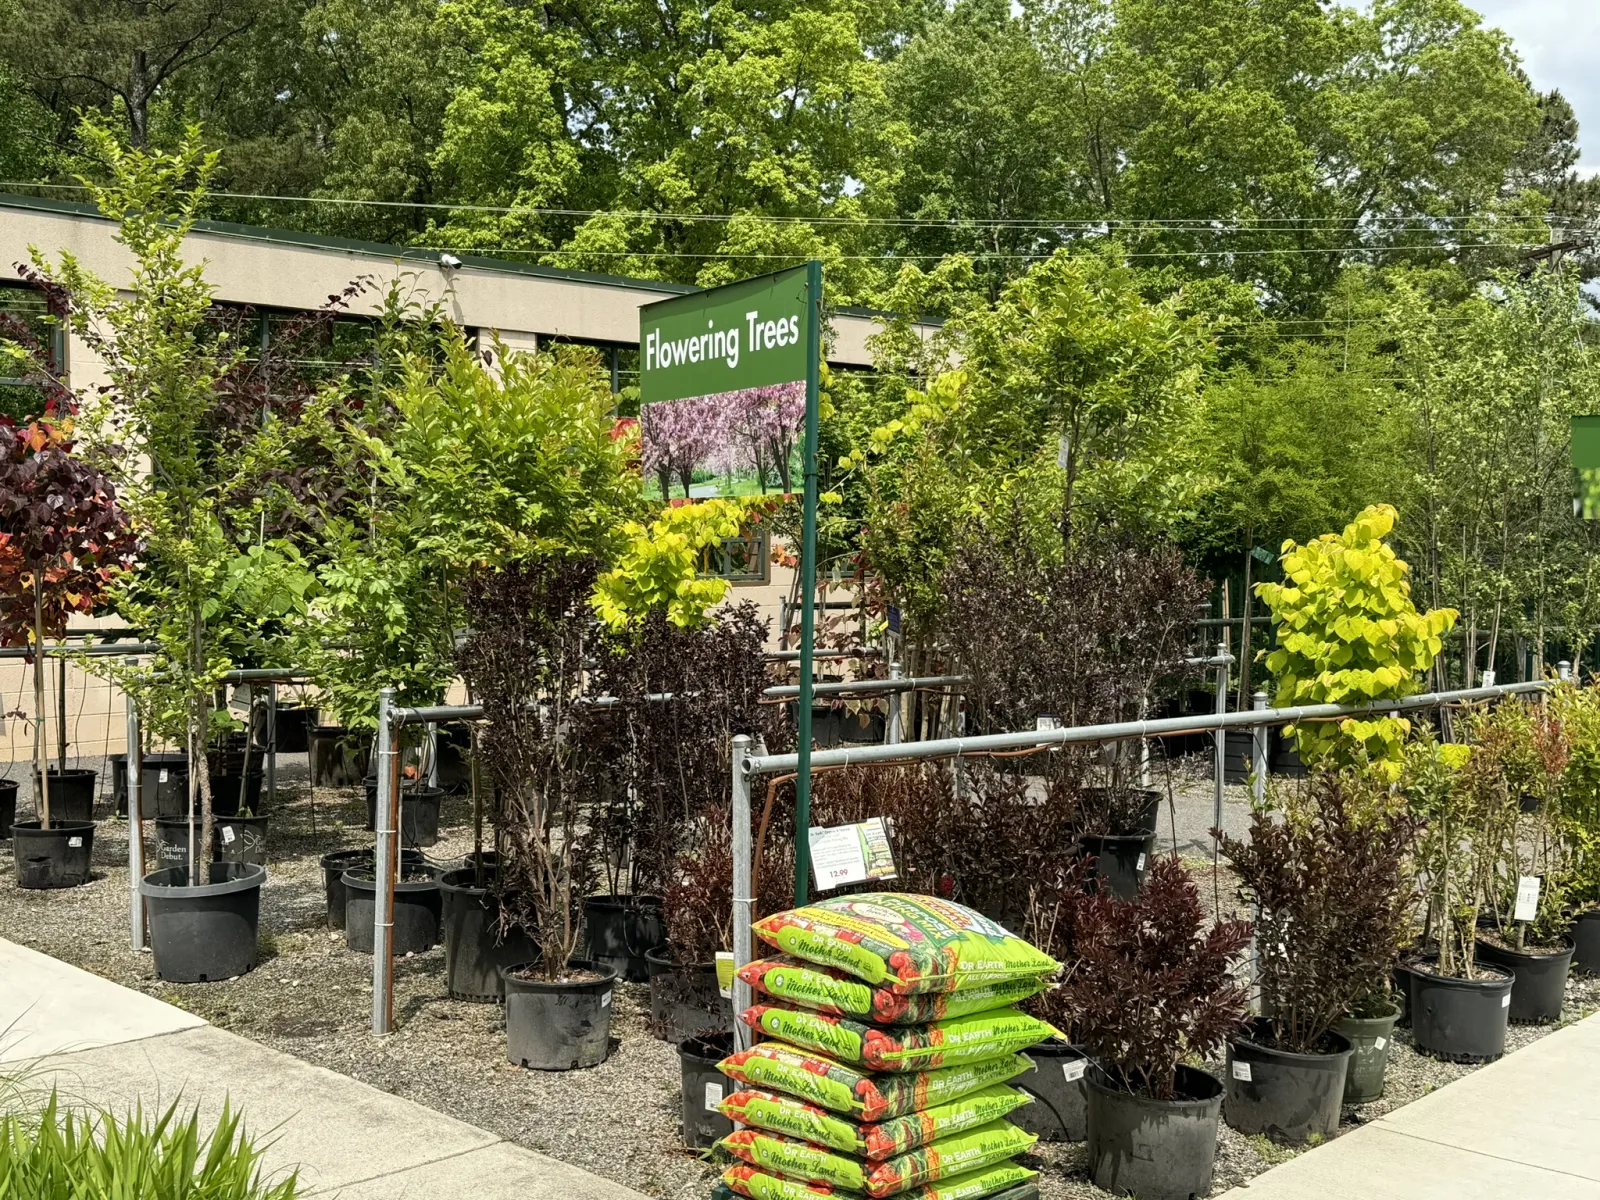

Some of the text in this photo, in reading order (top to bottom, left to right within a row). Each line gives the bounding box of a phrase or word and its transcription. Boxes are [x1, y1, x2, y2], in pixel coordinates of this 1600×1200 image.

[646, 310, 799, 370] Flowering Trees
[161, 842, 186, 853] Garden
[829, 868, 848, 878] 12.99
[887, 898, 955, 937] PURPOSE
[917, 919, 947, 940] MIX
[834, 947, 862, 969] Land
[977, 960, 1004, 970] EARTH
[1005, 959, 1031, 969] Mother
[1031, 957, 1050, 967] Land
[786, 978, 822, 996] Mother
[782, 1021, 814, 1039] Mother
[964, 1029, 992, 1041] EARTH
[992, 1025, 1020, 1036] Mother
[1021, 1021, 1042, 1031] Land
[764, 1069, 798, 1087] Mother
[947, 1072, 972, 1085] EARTH
[973, 1062, 998, 1076] Mother
[974, 1102, 999, 1114] Mother
[766, 1111, 802, 1130] Mother
[954, 1148, 981, 1158] EARTH
[980, 1140, 1004, 1153] Mother
[1005, 1136, 1022, 1147] Land
[771, 1152, 808, 1171] Mother
[810, 1161, 837, 1178] Land
[955, 1184, 981, 1197] EARTH
[980, 1177, 1004, 1189] Mother
